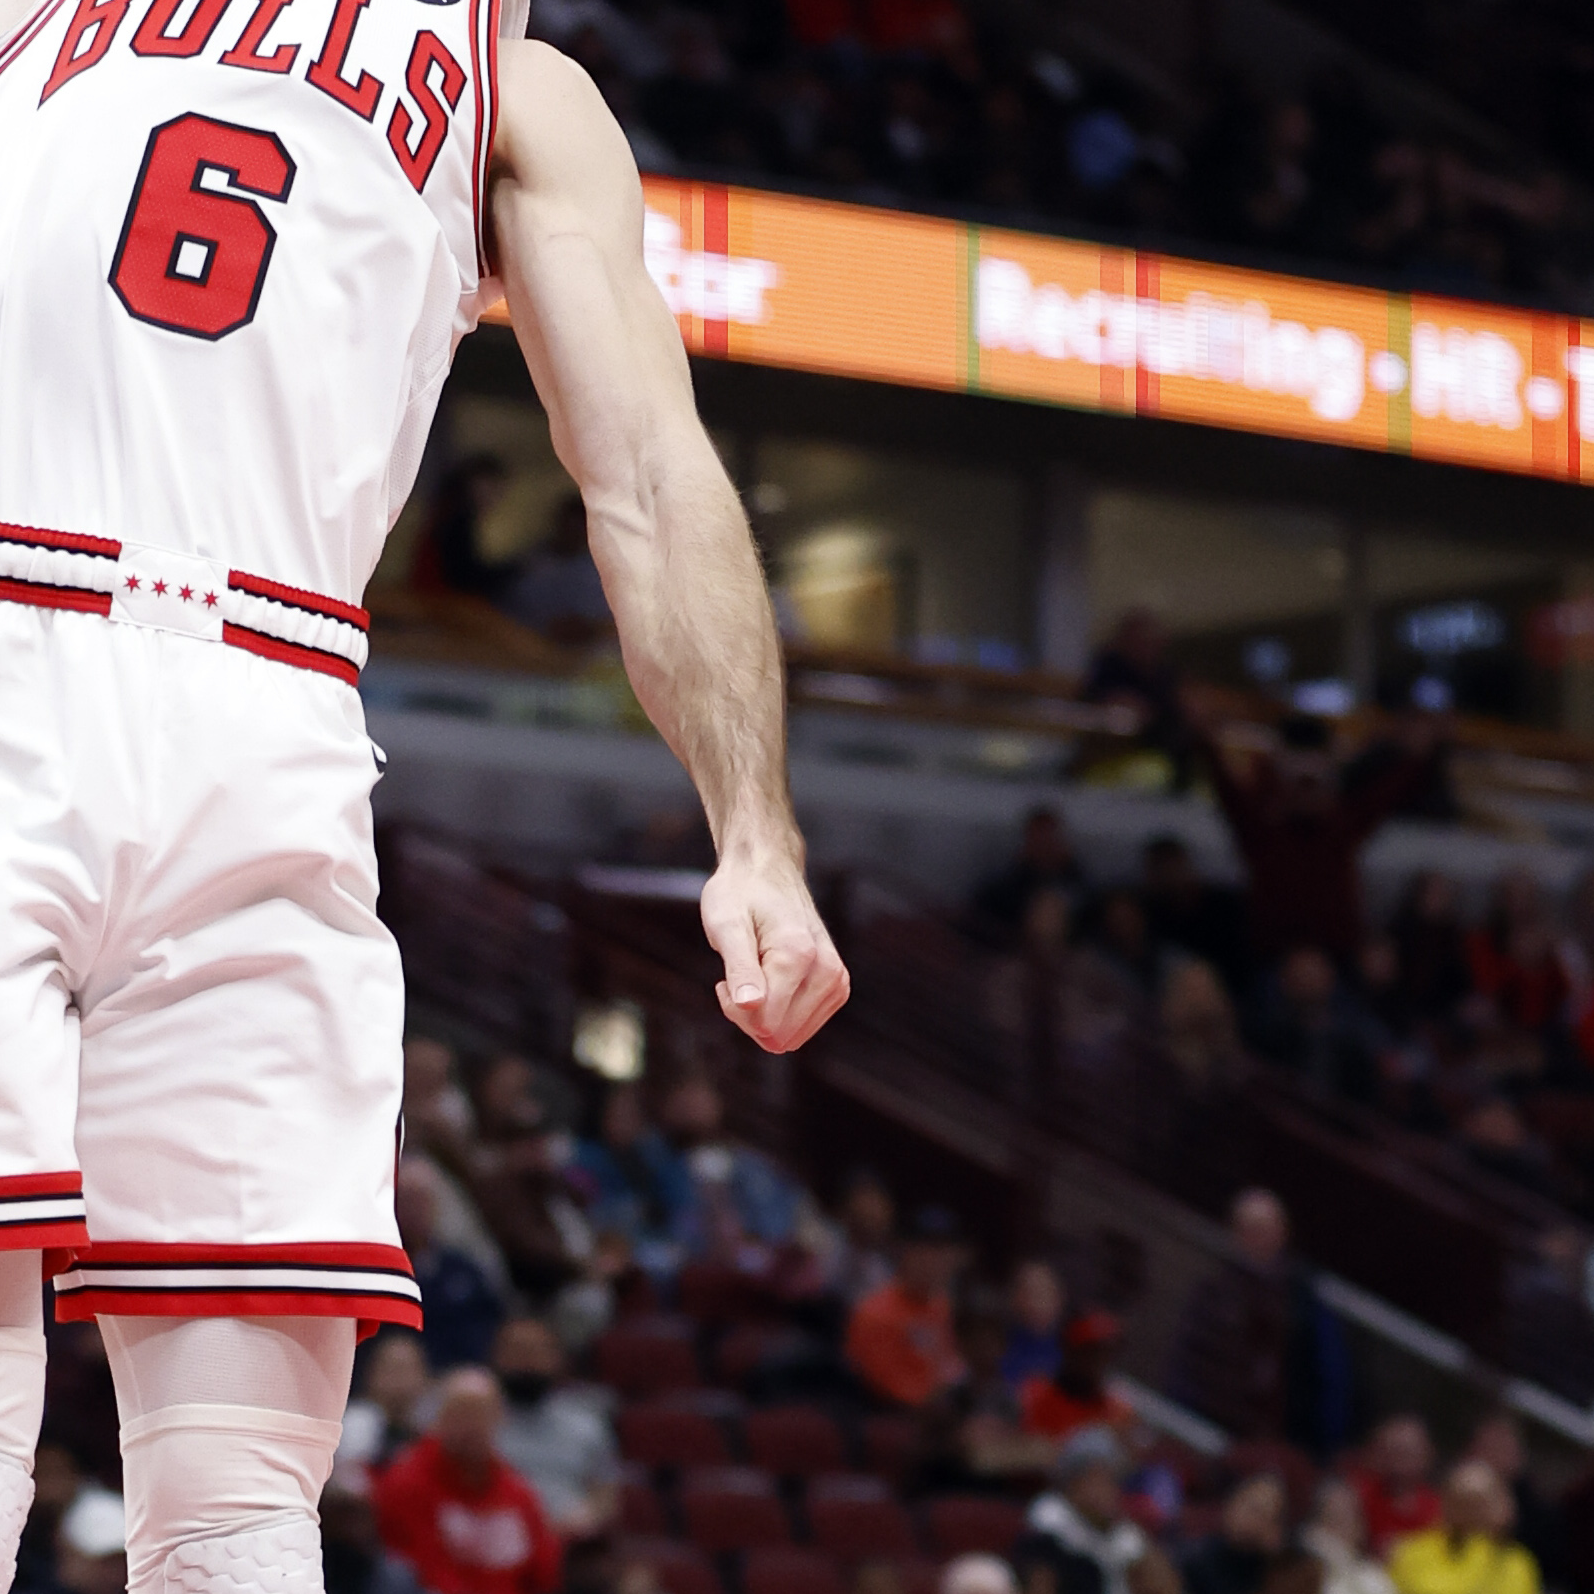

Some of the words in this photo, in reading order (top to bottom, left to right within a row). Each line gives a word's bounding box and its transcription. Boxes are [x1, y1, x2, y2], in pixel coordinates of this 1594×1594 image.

[107, 110, 298, 343] 6
[978, 255, 1366, 422] Recruiting
[1411, 321, 1524, 431] HR
